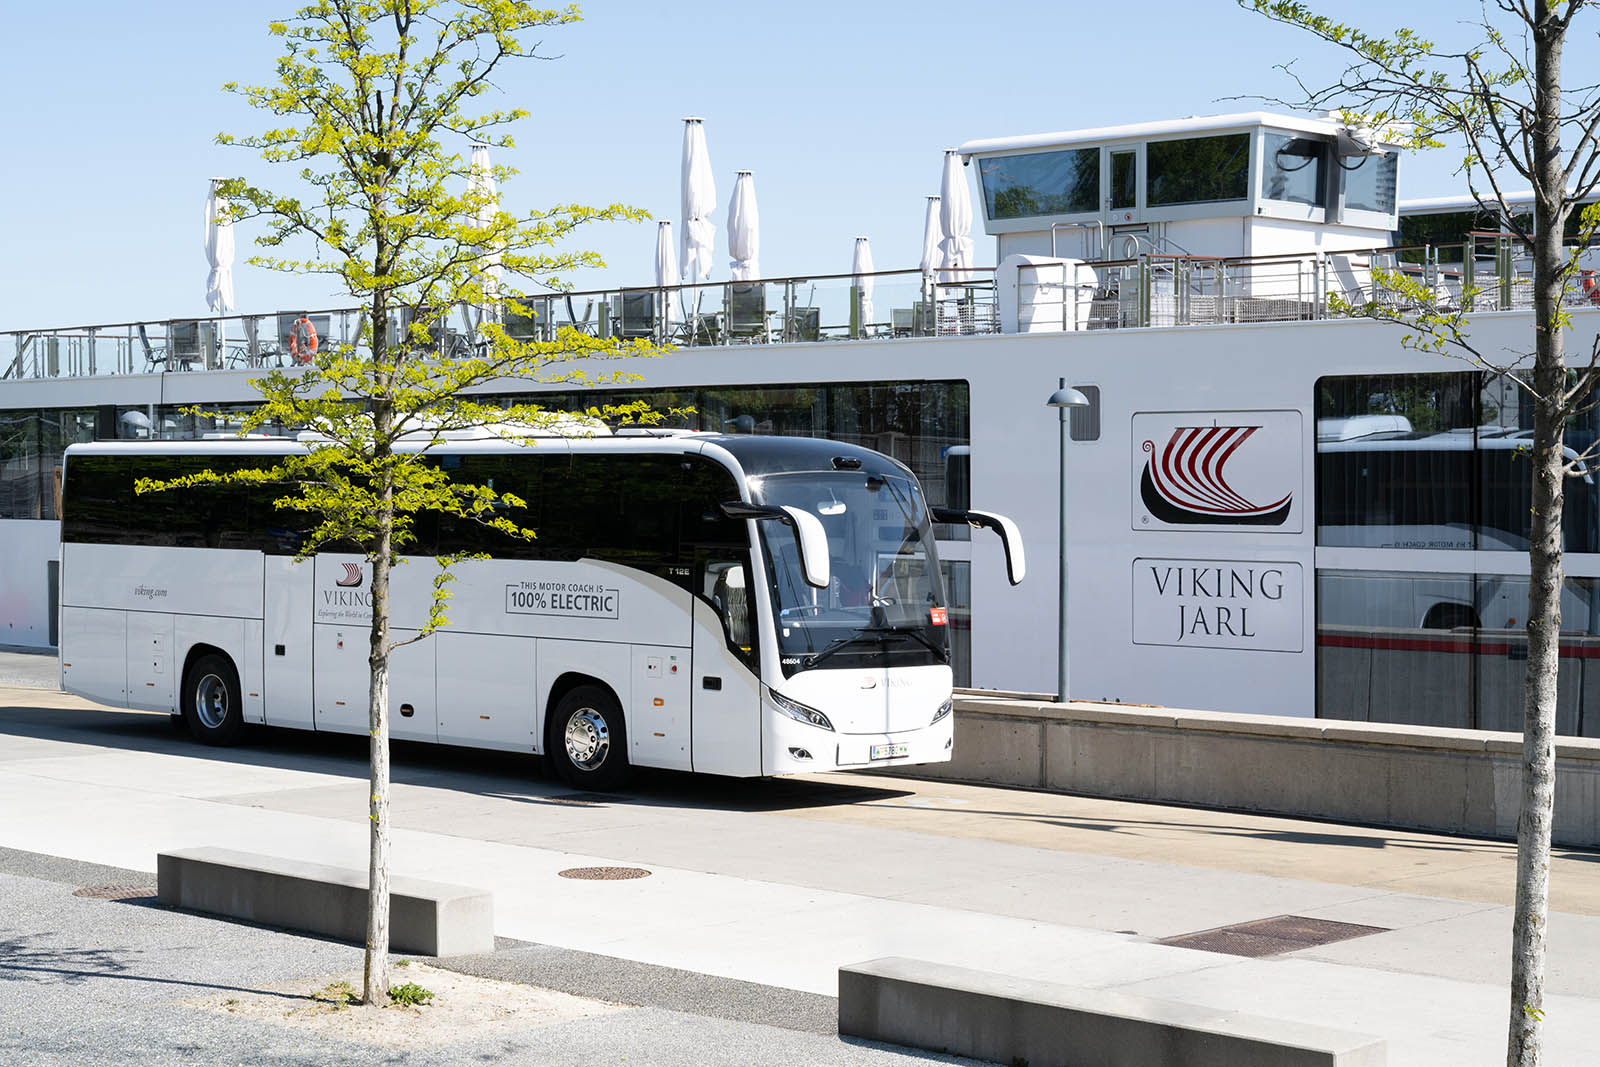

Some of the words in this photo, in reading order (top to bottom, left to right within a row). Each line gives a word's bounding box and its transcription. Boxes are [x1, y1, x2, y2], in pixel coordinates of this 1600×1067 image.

[134, 584, 168, 600] viking.com
[520, 581, 536, 590] THIS
[539, 582, 566, 592] MOTOR
[568, 583, 594, 593] COACH
[597, 585, 604, 593] IS
[1151, 566, 1284, 600] VIKING
[511, 591, 547, 609] 100%
[551, 593, 613, 612] ELECTRIC
[1177, 605, 1256, 642] JARL
